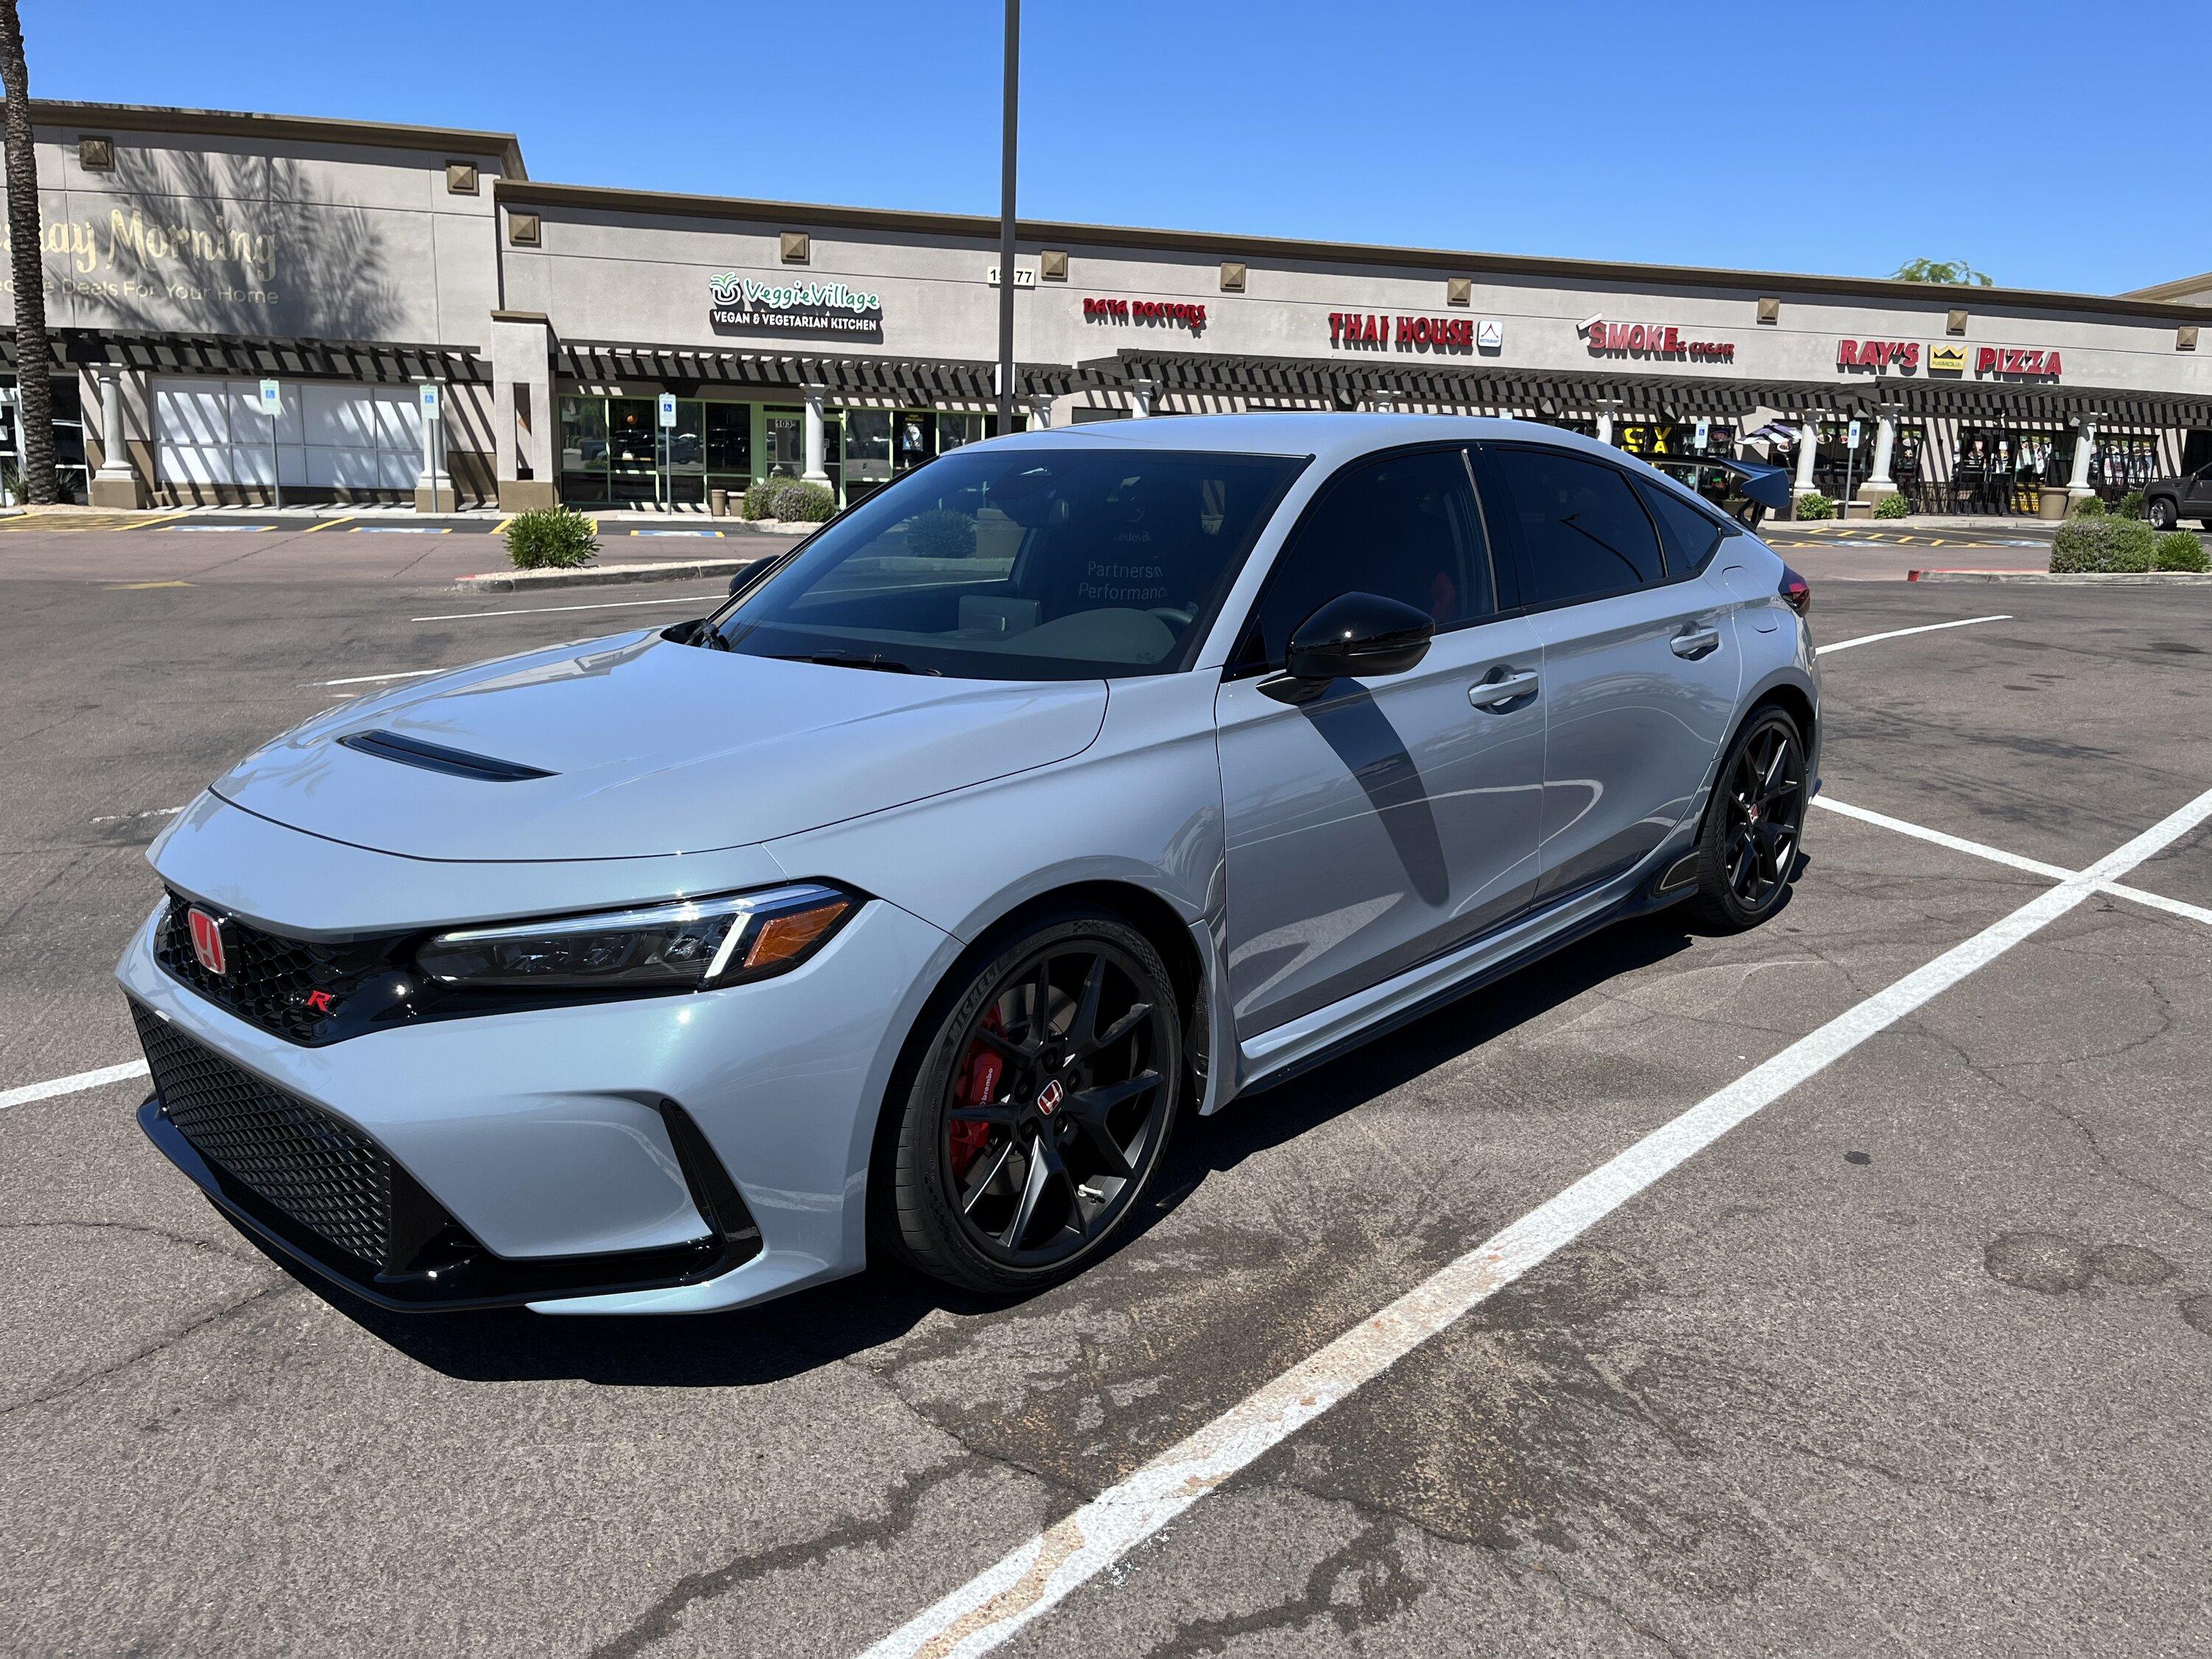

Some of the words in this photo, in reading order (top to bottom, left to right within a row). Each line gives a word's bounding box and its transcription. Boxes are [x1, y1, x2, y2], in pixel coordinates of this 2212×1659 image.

[107, 209, 276, 282] Morning
[990, 268, 1032, 283] 177
[62, 279, 118, 296] Deals
[123, 281, 158, 298] For
[166, 285, 210, 301] Your
[219, 286, 279, 305] Home
[713, 310, 751, 324] VEGAN
[752, 314, 759, 324] &
[762, 314, 829, 328] VEGETARIAN
[830, 319, 877, 331] KITCHEN
[1082, 298, 1129, 316] DATA
[1132, 301, 1207, 328] DOCTORS
[1328, 313, 1390, 344] THAI
[1396, 316, 1474, 347] HOUSE
[1587, 321, 1679, 352] SMOKE
[1676, 341, 1688, 352] &
[1688, 341, 1735, 355] CIGAR
[1839, 339, 1921, 368] RAY'S
[1976, 347, 2062, 376] PIZZA
[776, 420, 792, 428] 103
[306, 990, 333, 1012] R
[981, 1067, 994, 1102] brembo
